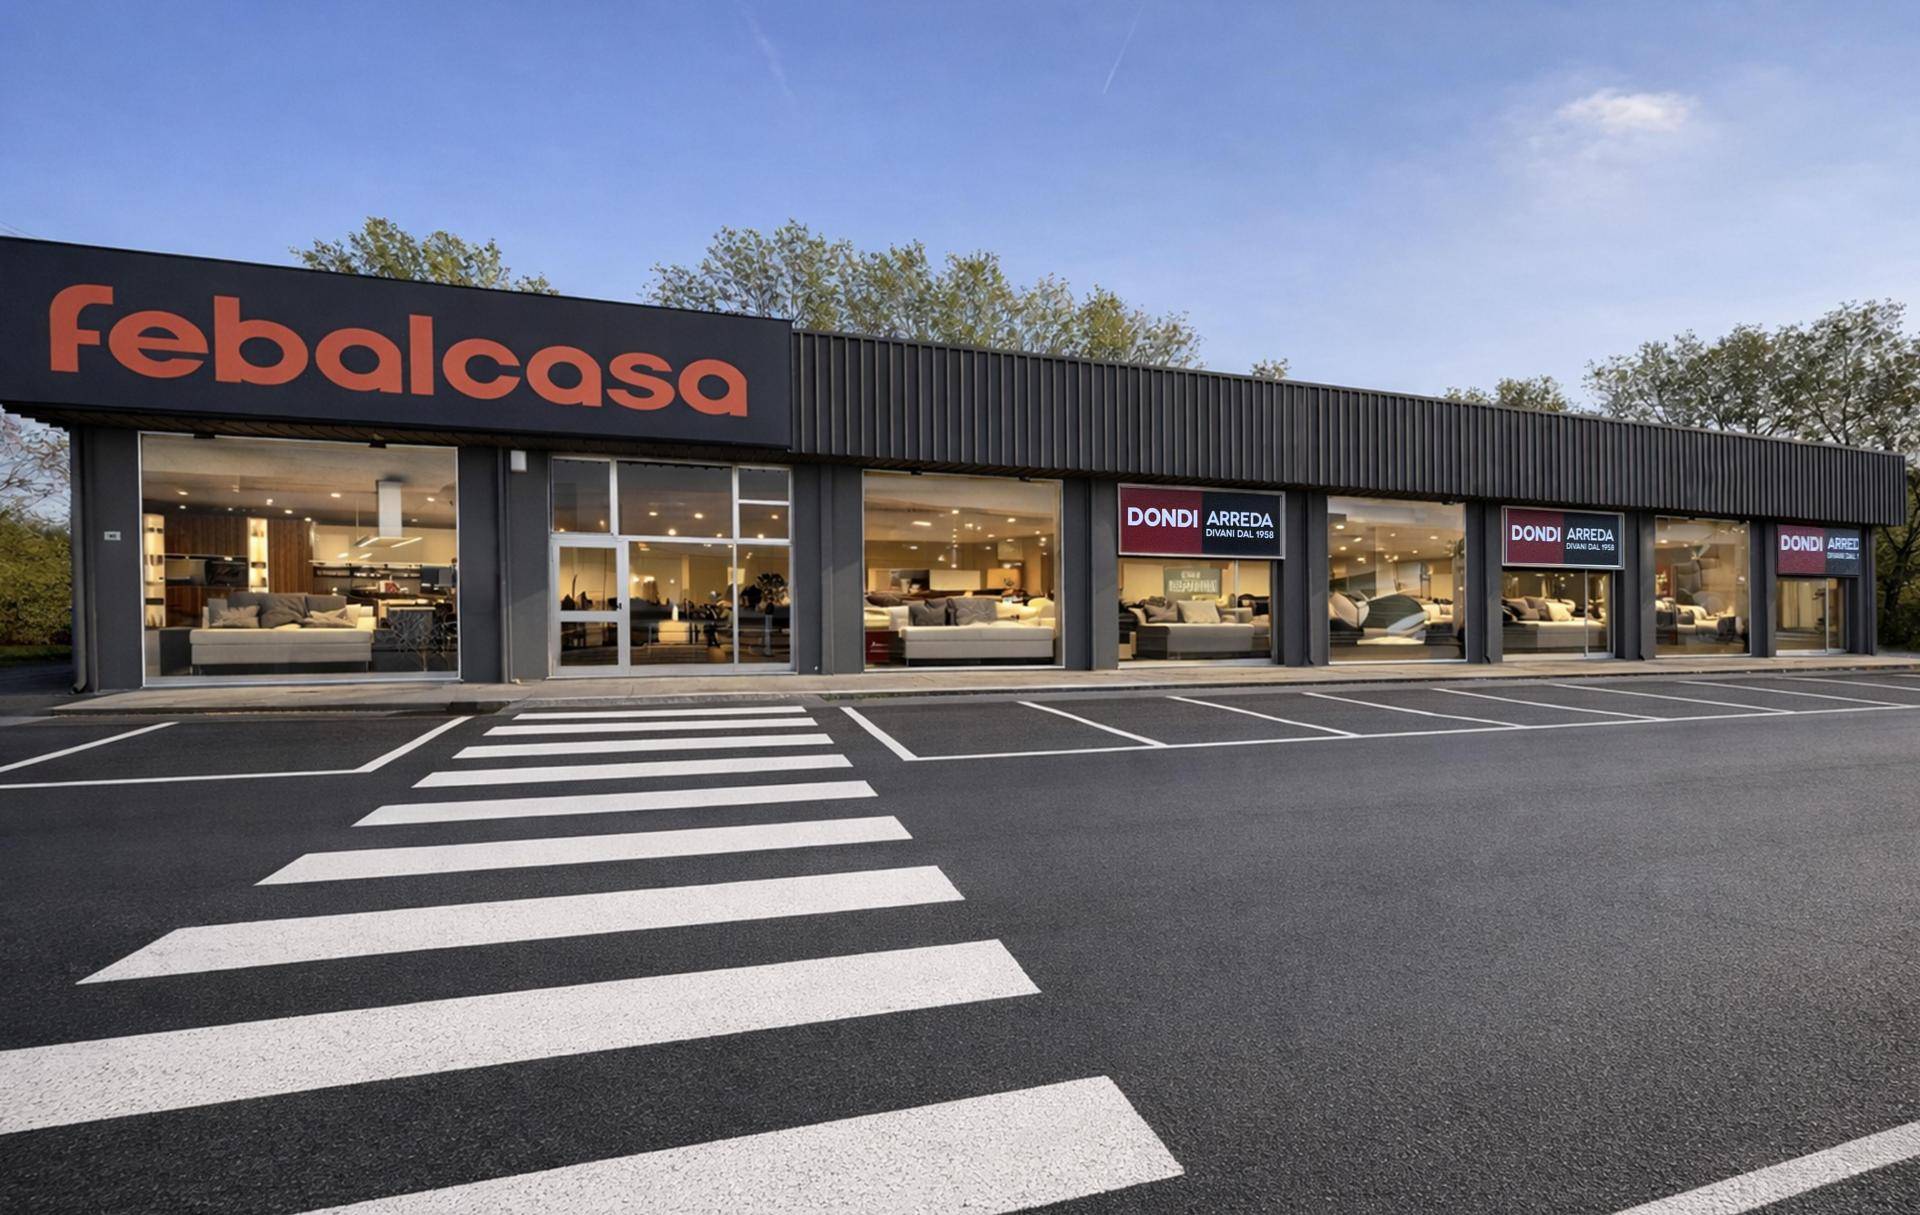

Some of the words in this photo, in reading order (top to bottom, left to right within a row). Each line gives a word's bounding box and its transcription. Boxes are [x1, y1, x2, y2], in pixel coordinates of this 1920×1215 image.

[49, 284, 748, 418] febalcasa
[1127, 506, 1198, 528] DONDI
[1206, 510, 1274, 528] ARREDA
[1205, 528, 1235, 538] DIVANI
[1237, 529, 1254, 539] DAL
[1256, 530, 1274, 539] 1958
[1511, 524, 1561, 543] DONDI
[1566, 527, 1615, 542] ARREDA
[1566, 542, 1587, 550] DIVANI
[1588, 543, 1601, 551] DAL
[1780, 534, 1824, 552] DONDI
